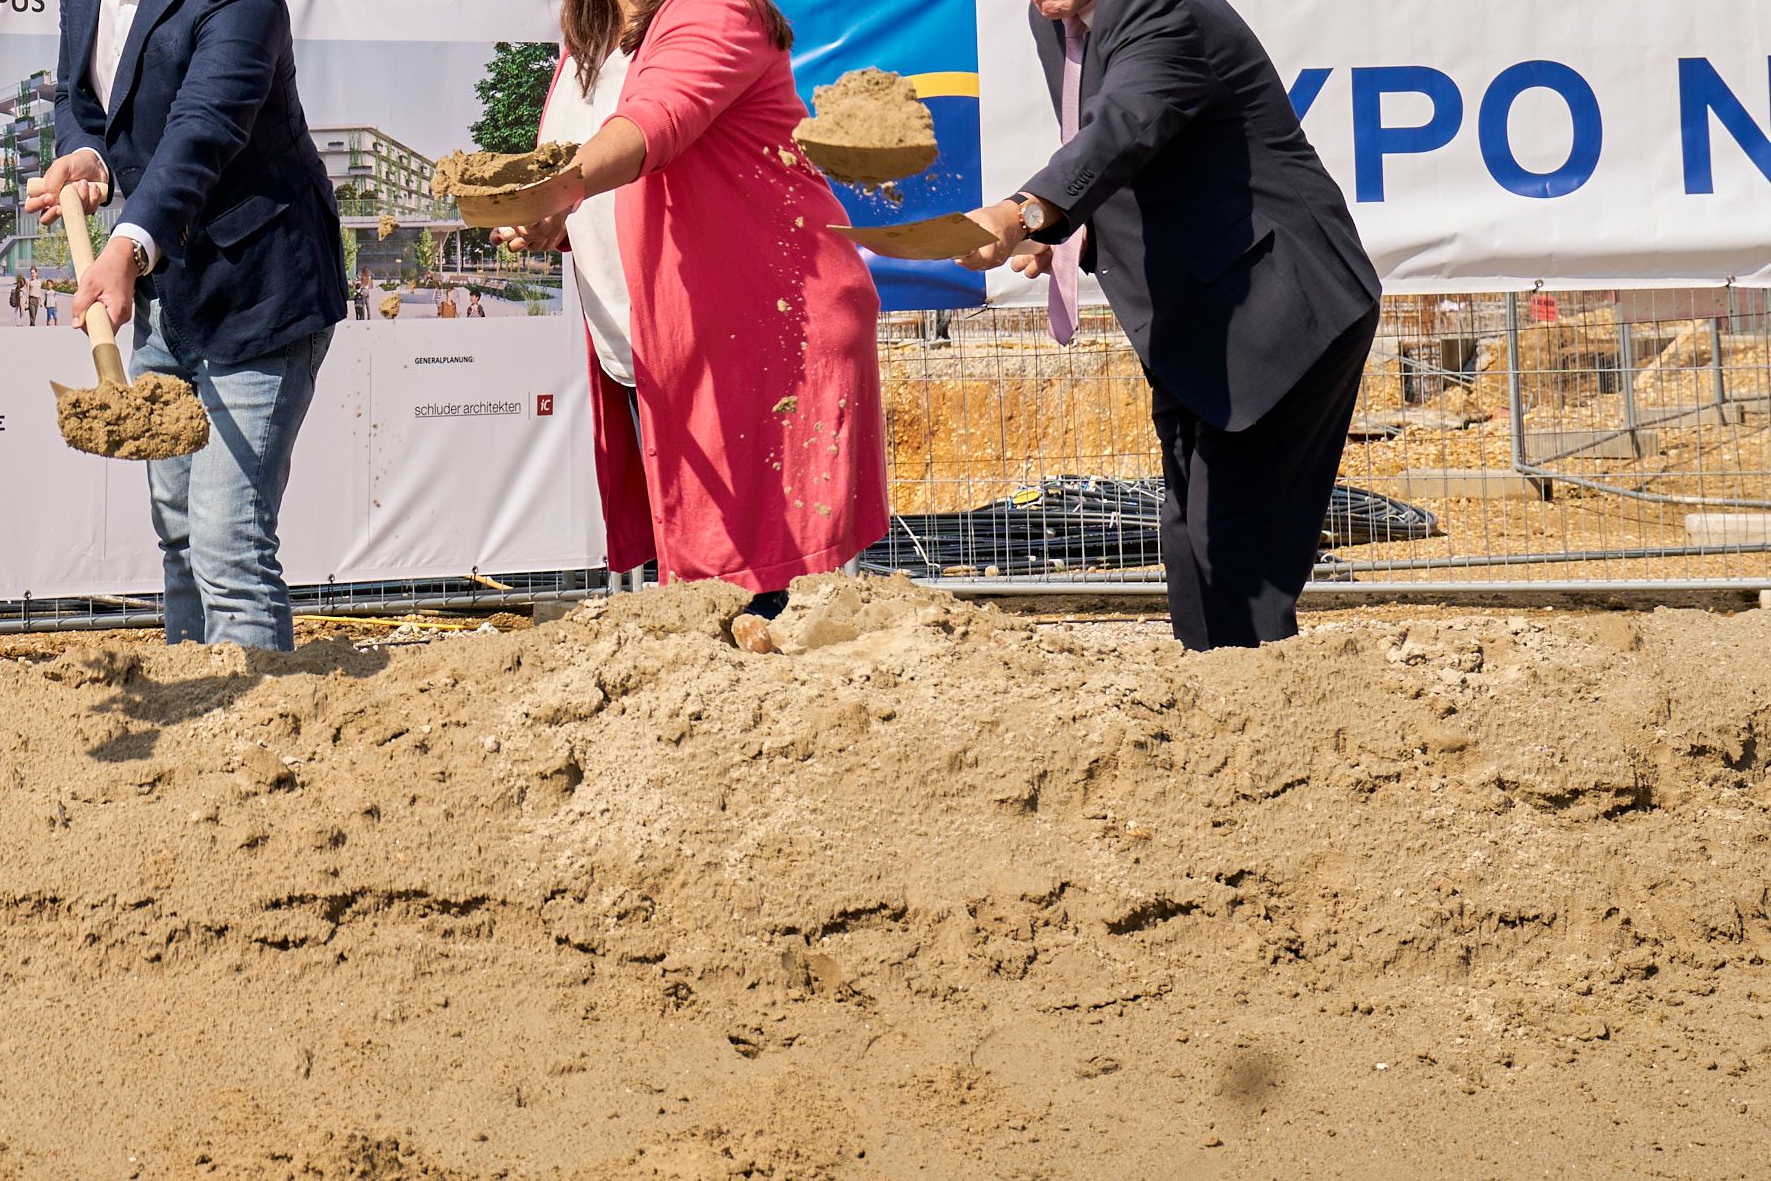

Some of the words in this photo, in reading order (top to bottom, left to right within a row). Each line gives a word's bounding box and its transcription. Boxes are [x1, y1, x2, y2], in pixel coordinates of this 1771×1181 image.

[414, 356, 475, 364] GENERALPLANUNG:
[414, 403, 461, 416] schluder
[463, 401, 521, 414] architekten
